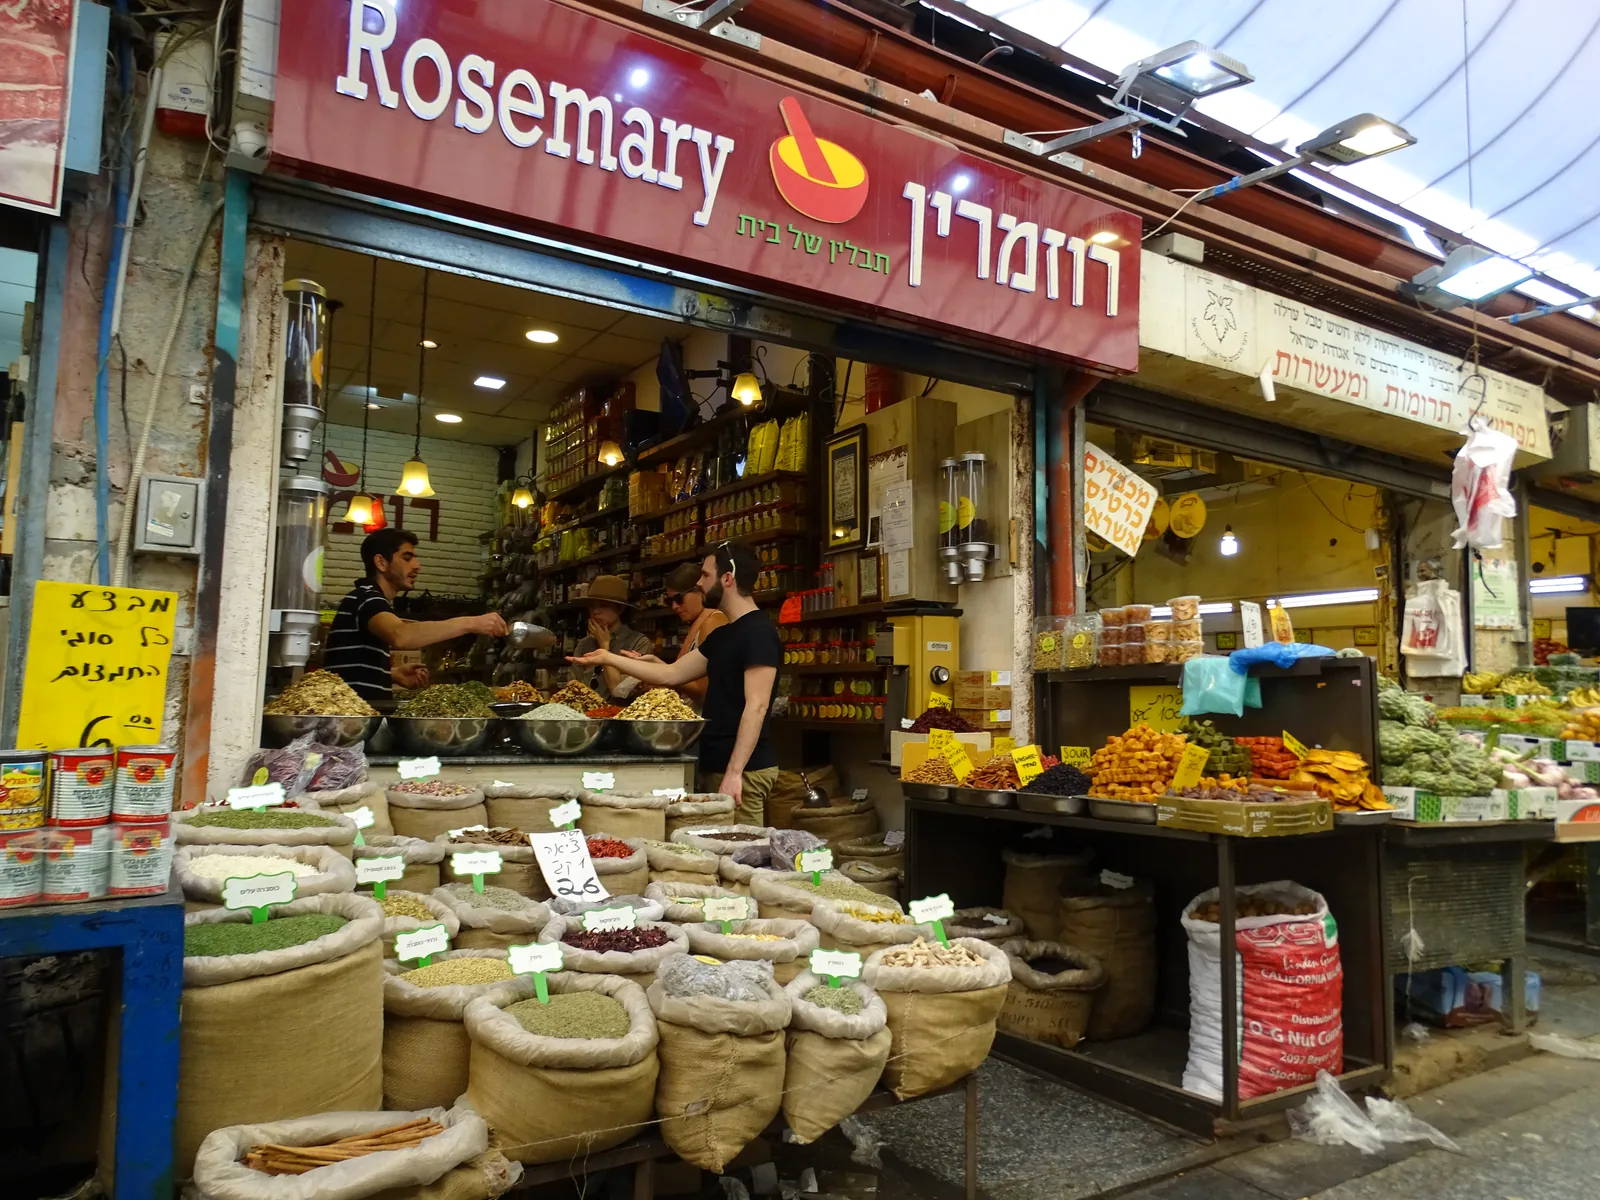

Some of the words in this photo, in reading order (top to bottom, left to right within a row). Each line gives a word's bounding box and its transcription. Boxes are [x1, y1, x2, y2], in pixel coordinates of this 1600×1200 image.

[335, 0, 735, 226] Rosemary
[736, 213, 782, 246] בית
[787, 223, 823, 255] של
[828, 240, 891, 275] תבלין
[902, 181, 1121, 318] רוזמרין
[1288, 326, 1318, 350] ישראל
[1271, 350, 1368, 401] ומעשרות
[1383, 384, 1453, 424] תרומות
[1084, 451, 1151, 509] מכבדים
[70, 590, 170, 613] מבצע
[60, 629, 113, 647] סוגי
[141, 627, 169, 647] כל
[1063, 747, 1090, 760] SOUR
[255, 885, 280, 893] כוסברה
[556, 876, 600, 895] 26
[1283, 955, 1319, 971] Linden
[1261, 969, 1327, 985] CALIFORNIA
[1288, 1031, 1316, 1047] Nut
[1280, 1052, 1305, 1064] 2097
